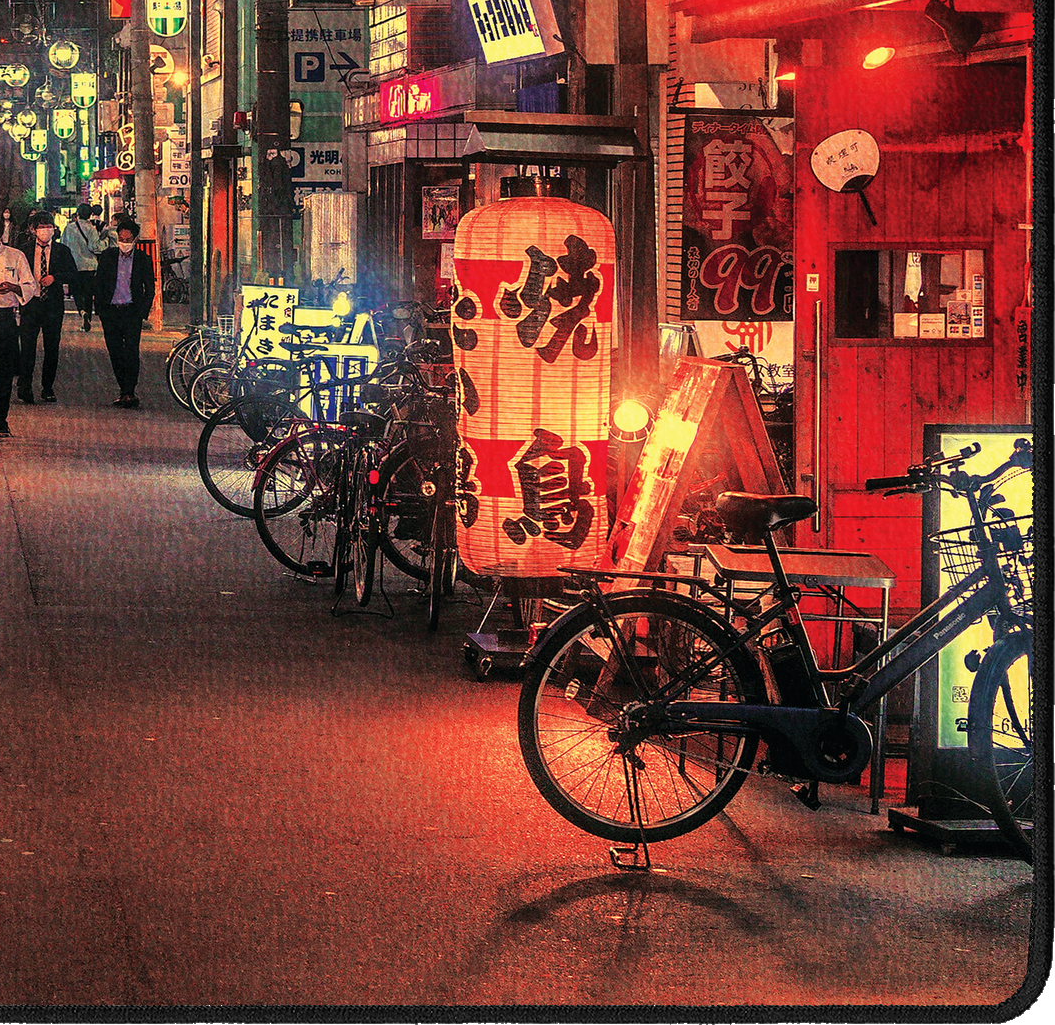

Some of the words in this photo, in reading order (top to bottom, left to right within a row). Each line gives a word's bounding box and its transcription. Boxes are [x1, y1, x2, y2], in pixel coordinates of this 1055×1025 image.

[291, 28, 362, 42] 提携駐車場
[301, 56, 320, 80] P
[702, 138, 753, 241] 餃子
[700, 244, 783, 316] 99
[498, 234, 602, 551] 焼鳥
[932, 612, 966, 640] Panasonic
